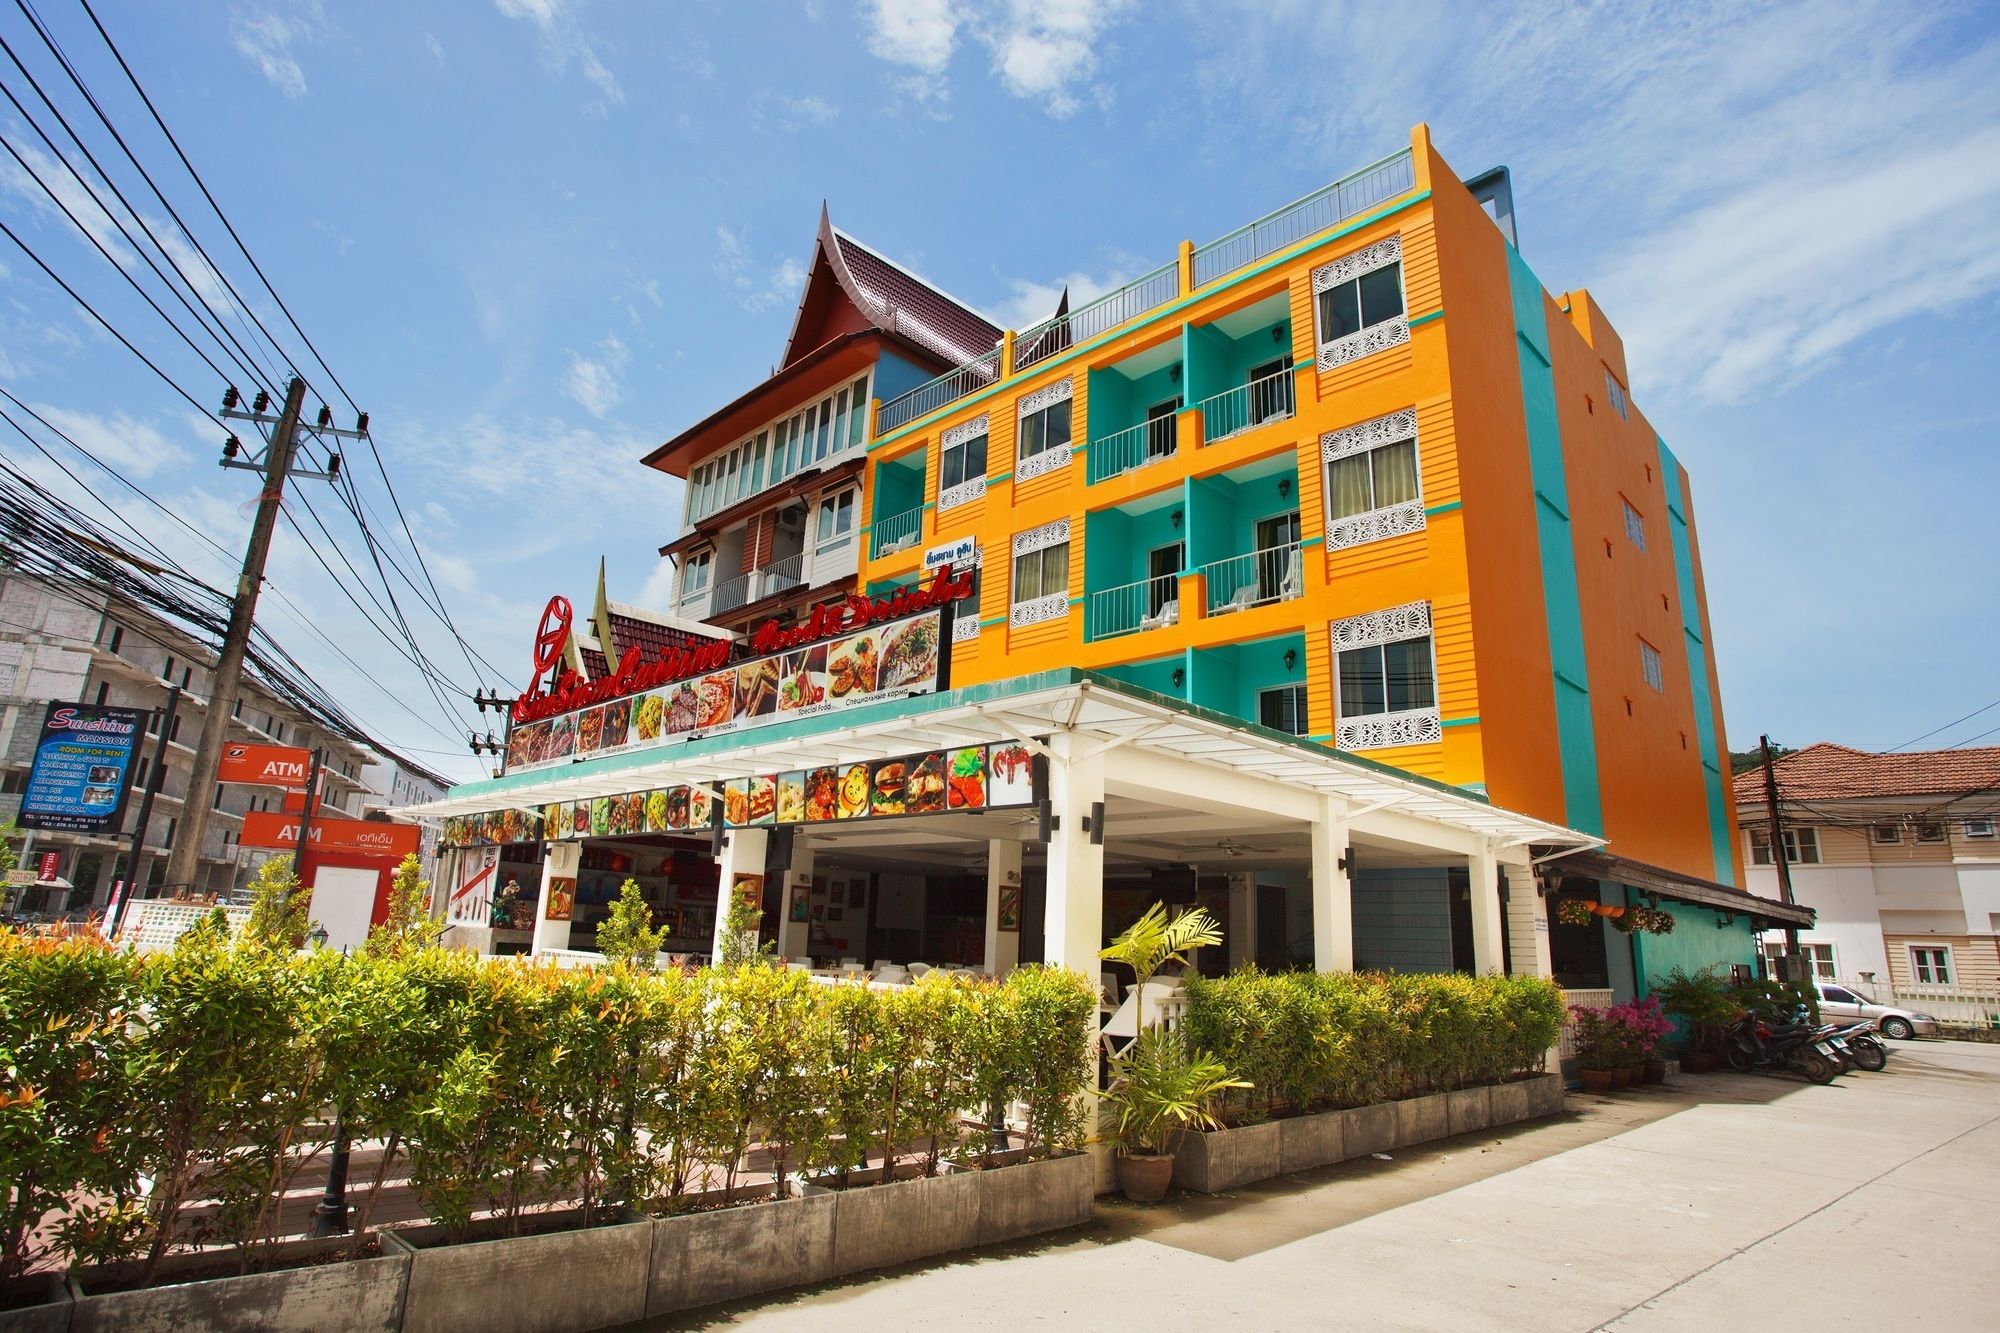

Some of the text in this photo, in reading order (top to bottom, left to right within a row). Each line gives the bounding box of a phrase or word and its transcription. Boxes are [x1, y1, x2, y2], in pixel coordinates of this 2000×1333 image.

[752, 603, 826, 655] Food
[614, 637, 731, 698] Cuisine
[845, 687, 909, 707] Специальные корма
[798, 702, 832, 716] Special Food
[48, 708, 134, 734] Sunshine
[76, 734, 130, 746] MANSION
[60, 746, 85, 754] ROOM
[262, 760, 304, 777] ATM
